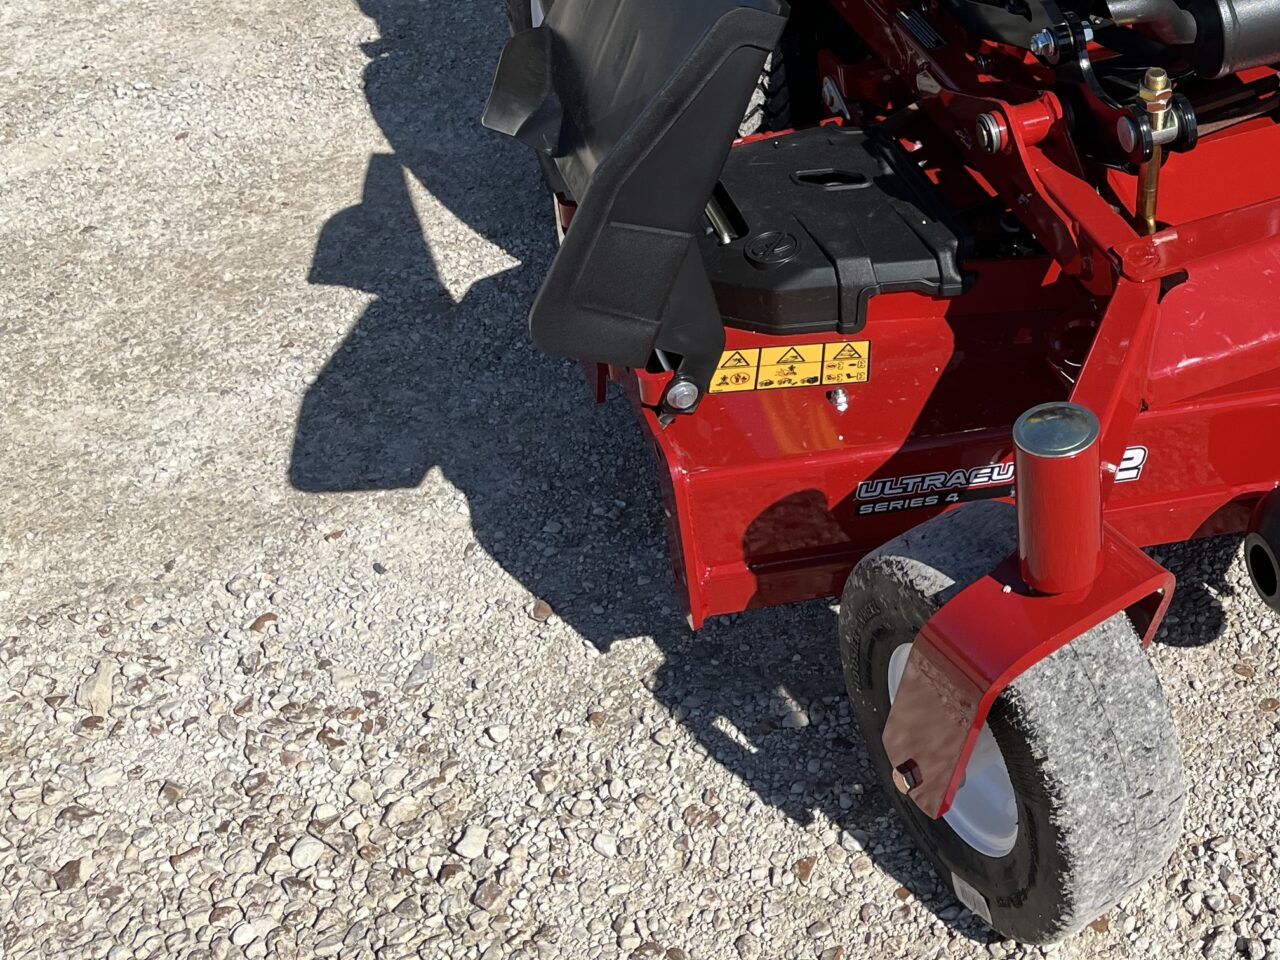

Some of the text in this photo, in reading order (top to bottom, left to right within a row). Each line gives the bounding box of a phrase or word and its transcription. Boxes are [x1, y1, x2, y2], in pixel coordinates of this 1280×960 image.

[855, 446, 1148, 500] ULTRACU 2
[859, 492, 959, 514] SERIES 4
